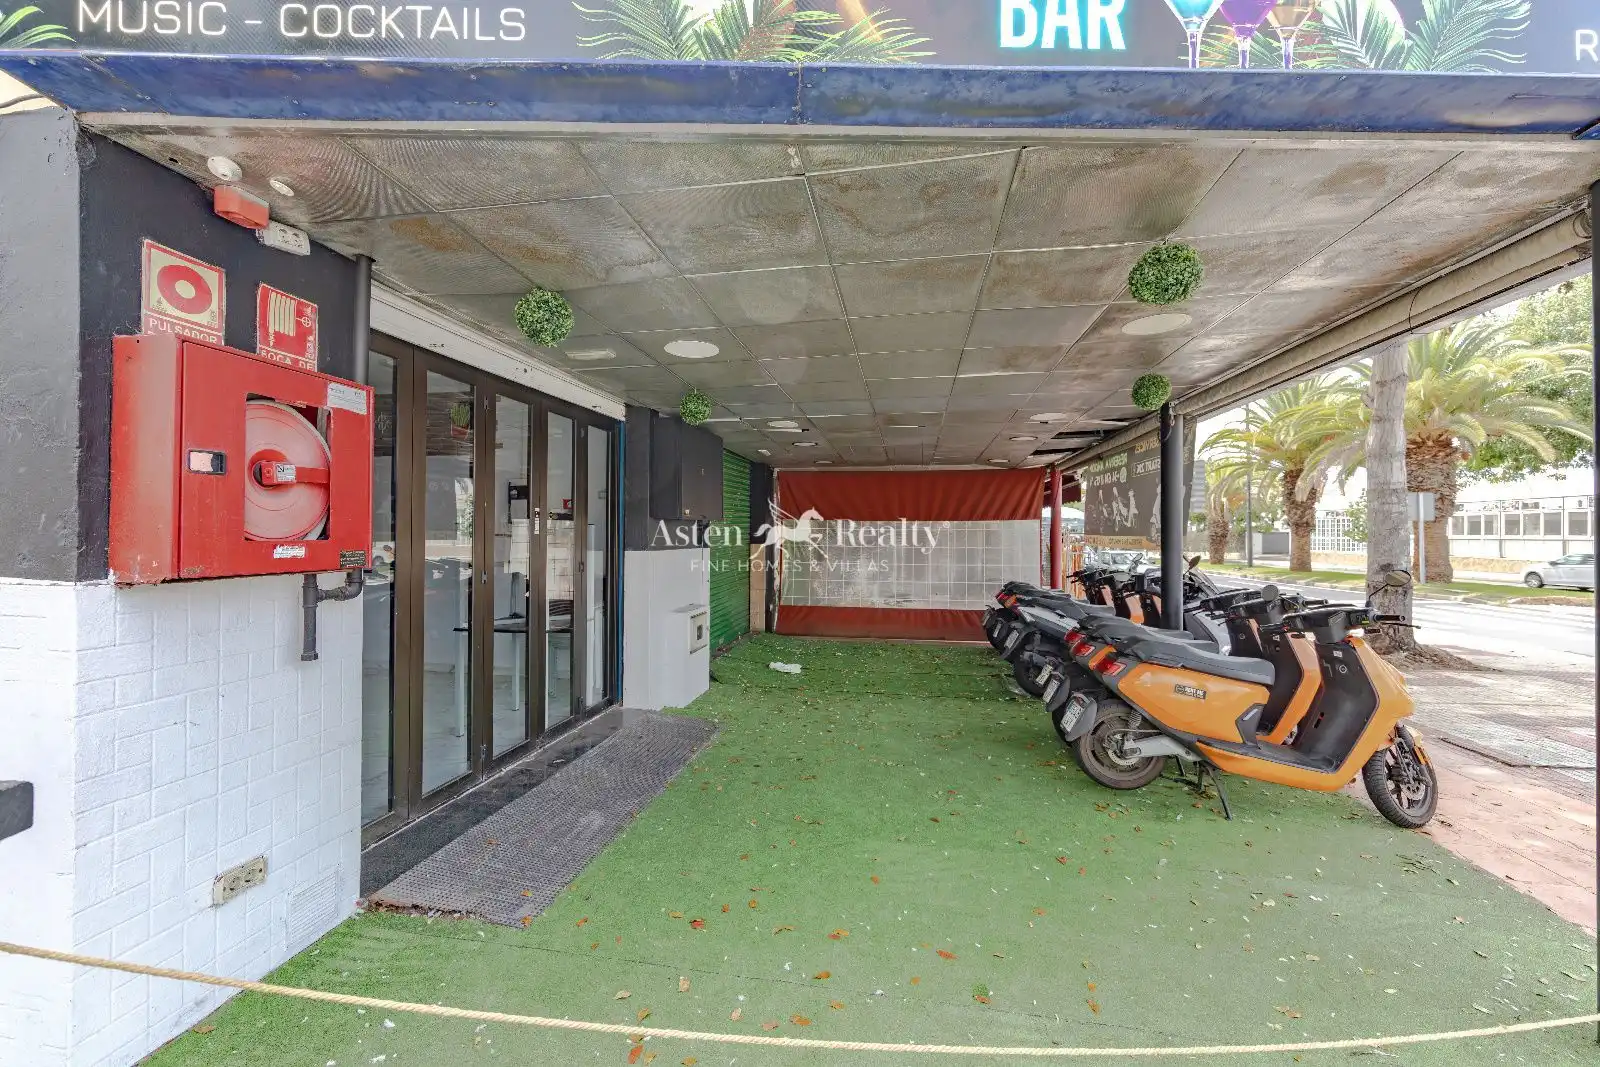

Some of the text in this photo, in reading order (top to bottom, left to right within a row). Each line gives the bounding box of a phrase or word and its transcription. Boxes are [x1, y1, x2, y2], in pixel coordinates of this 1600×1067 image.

[78, 0, 227, 35] MUSIC
[279, 3, 526, 41] COCKTAILS
[999, 0, 1127, 50] BAR
[149, 317, 218, 345] PULSADOR
